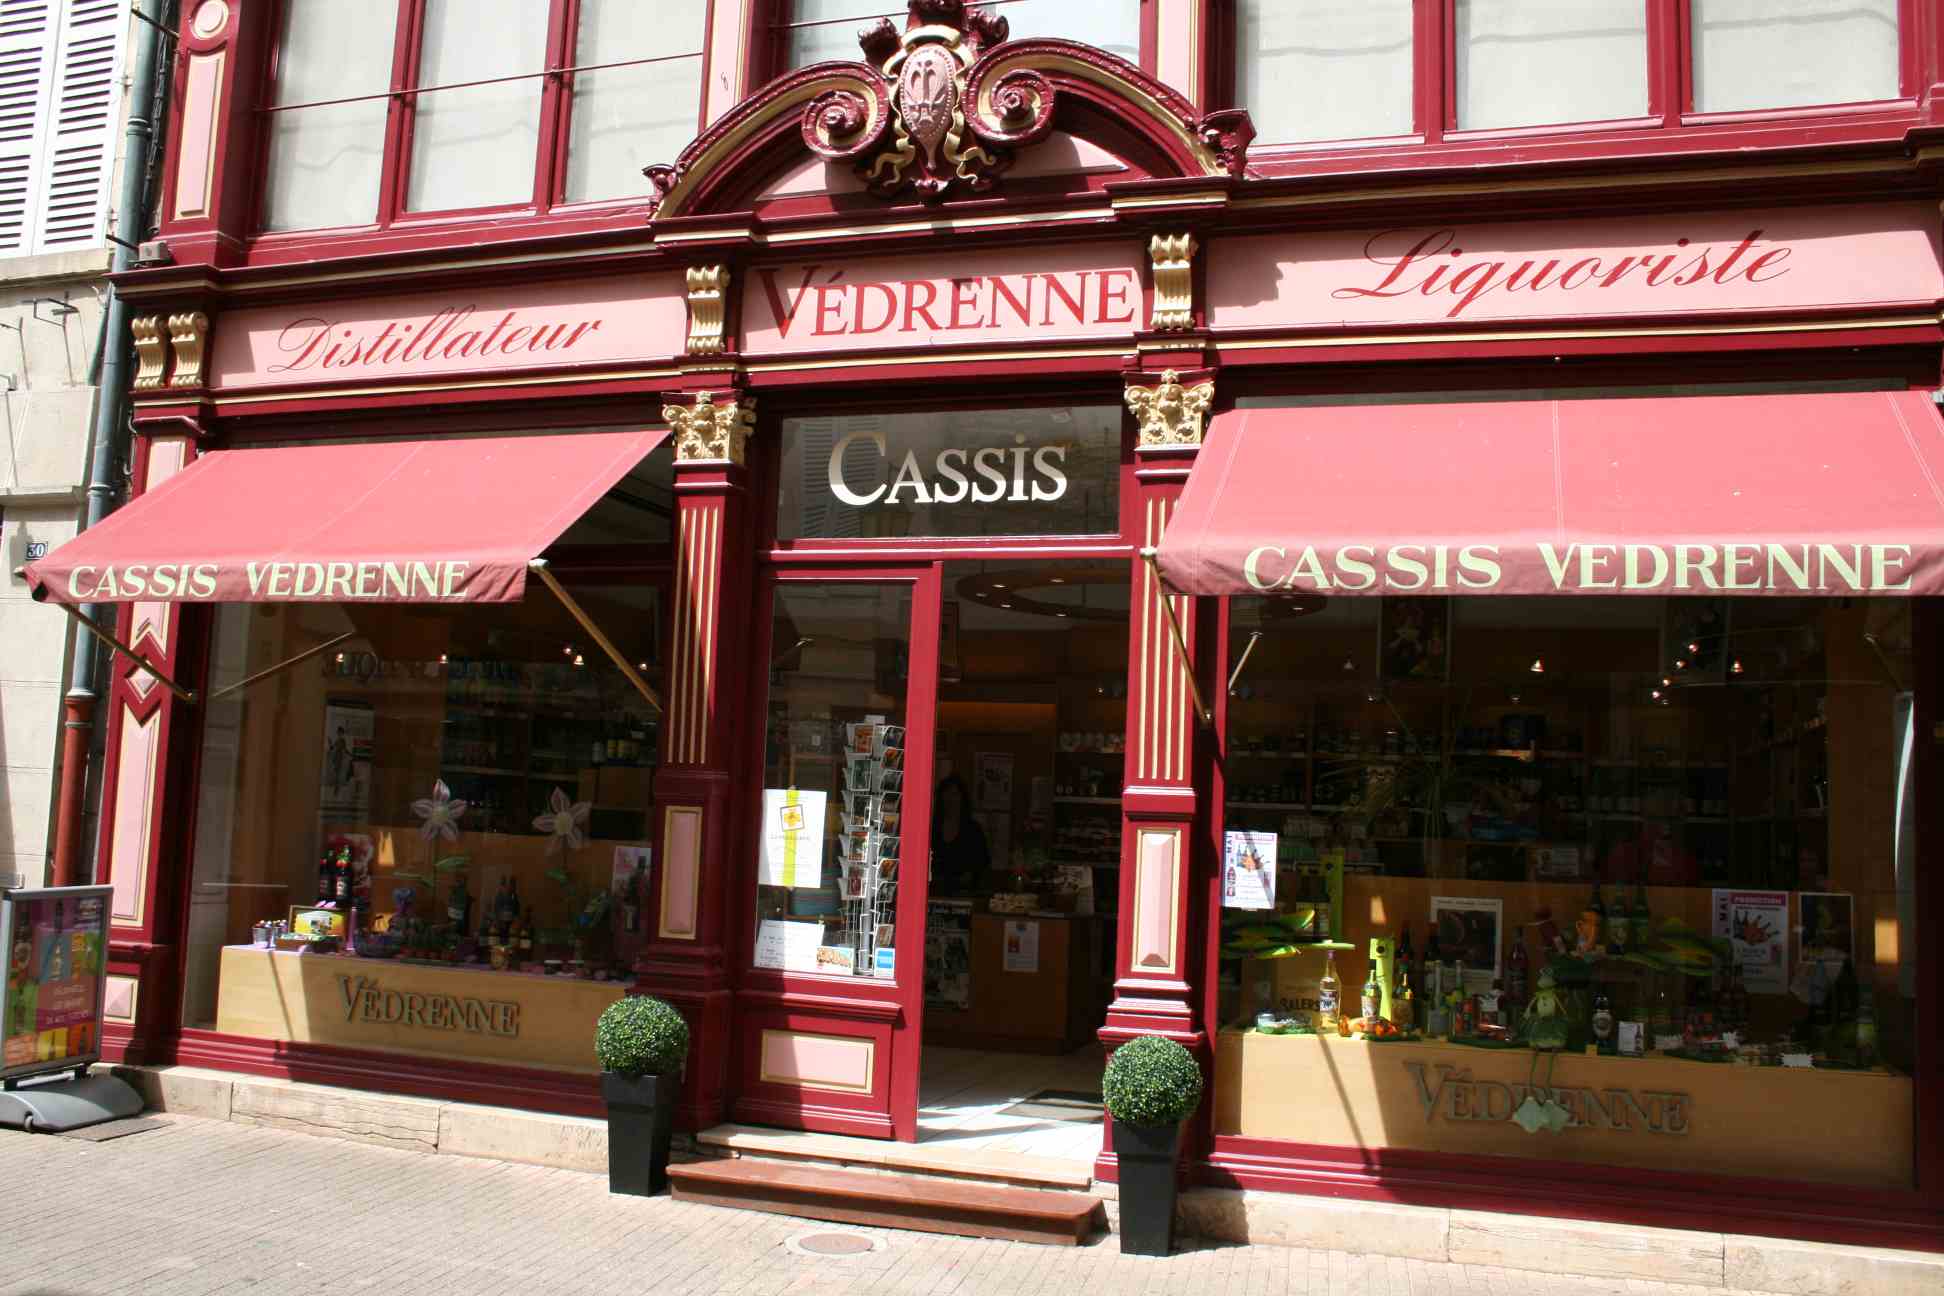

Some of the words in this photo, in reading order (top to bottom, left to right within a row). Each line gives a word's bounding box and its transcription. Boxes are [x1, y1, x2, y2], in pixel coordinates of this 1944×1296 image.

[756, 264, 1135, 340] VÉDRENNE
[1331, 228, 1792, 318] Liquoriste
[267, 303, 603, 373] Distillateur
[67, 563, 219, 598] CASSIS
[245, 559, 471, 598] VEDRENNE
[1243, 545, 1502, 591] CASSIS
[1536, 542, 1912, 592] VEDRENNE
[339, 975, 520, 1037] VÉDRENNE
[1406, 1062, 1690, 1134] VÉDENNE
